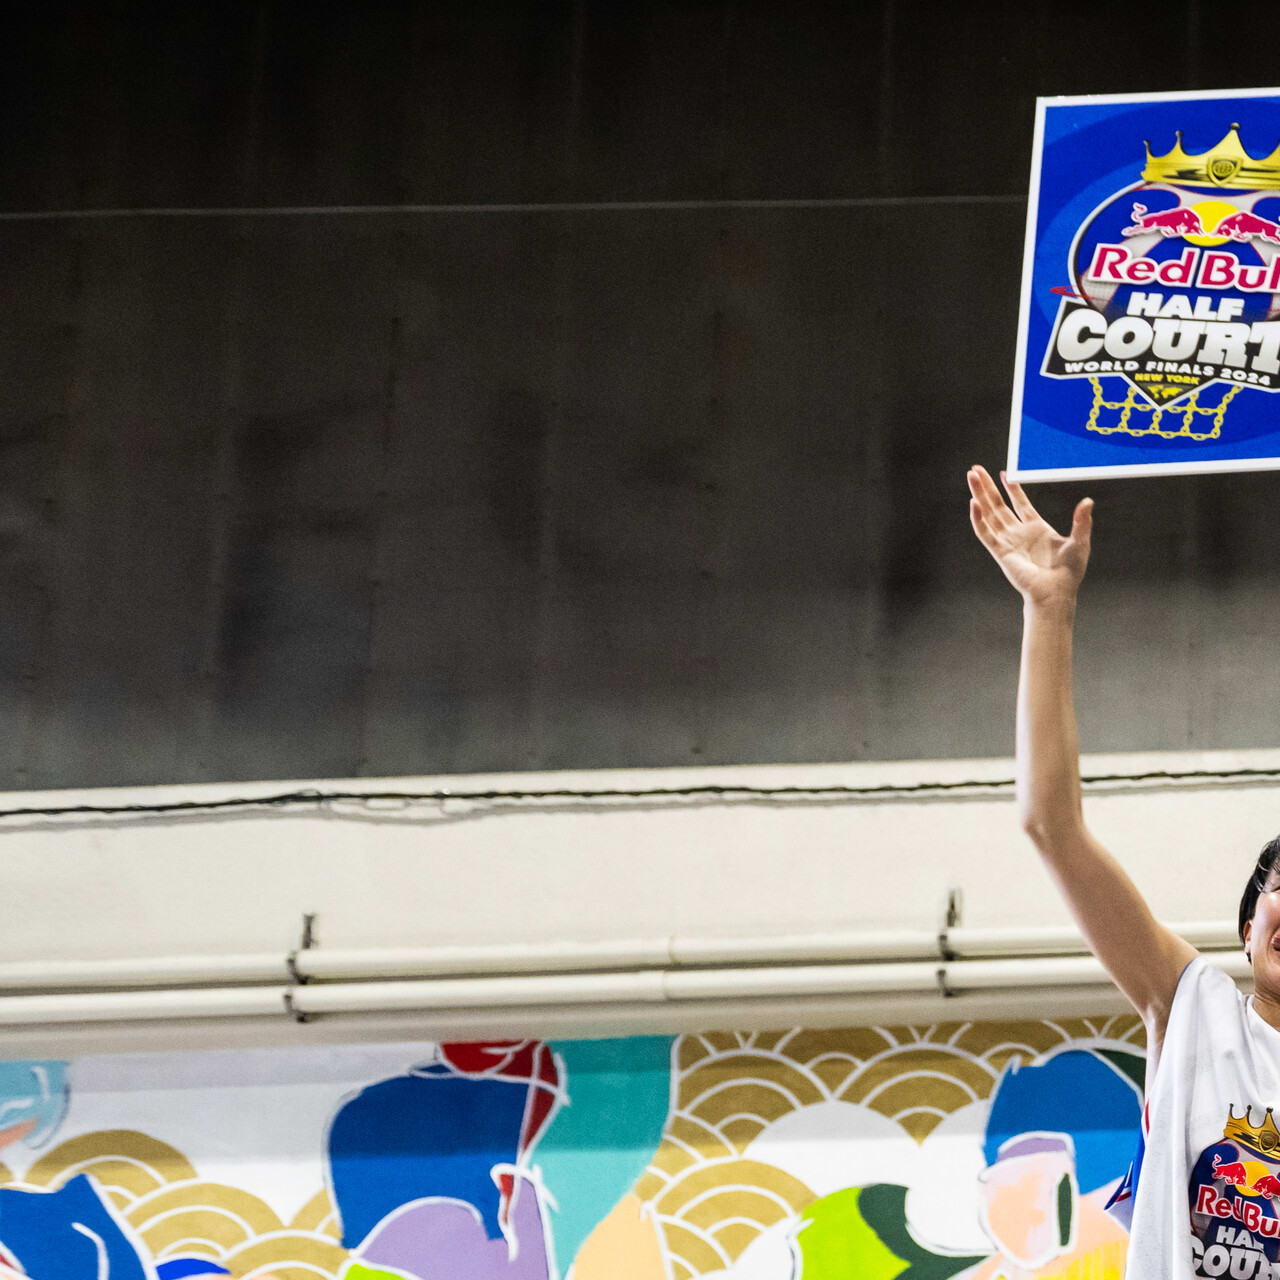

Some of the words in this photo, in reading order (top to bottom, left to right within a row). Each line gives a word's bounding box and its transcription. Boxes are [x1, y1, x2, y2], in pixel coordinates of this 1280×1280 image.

[1091, 246, 1199, 285] Red
[1126, 292, 1245, 322] HALF
[1064, 360, 1139, 374] WORLD
[1145, 361, 1214, 377] FINALS
[1219, 369, 1271, 386] 2024
[1134, 372, 1163, 383] NEW
[1166, 373, 1200, 386] YORK
